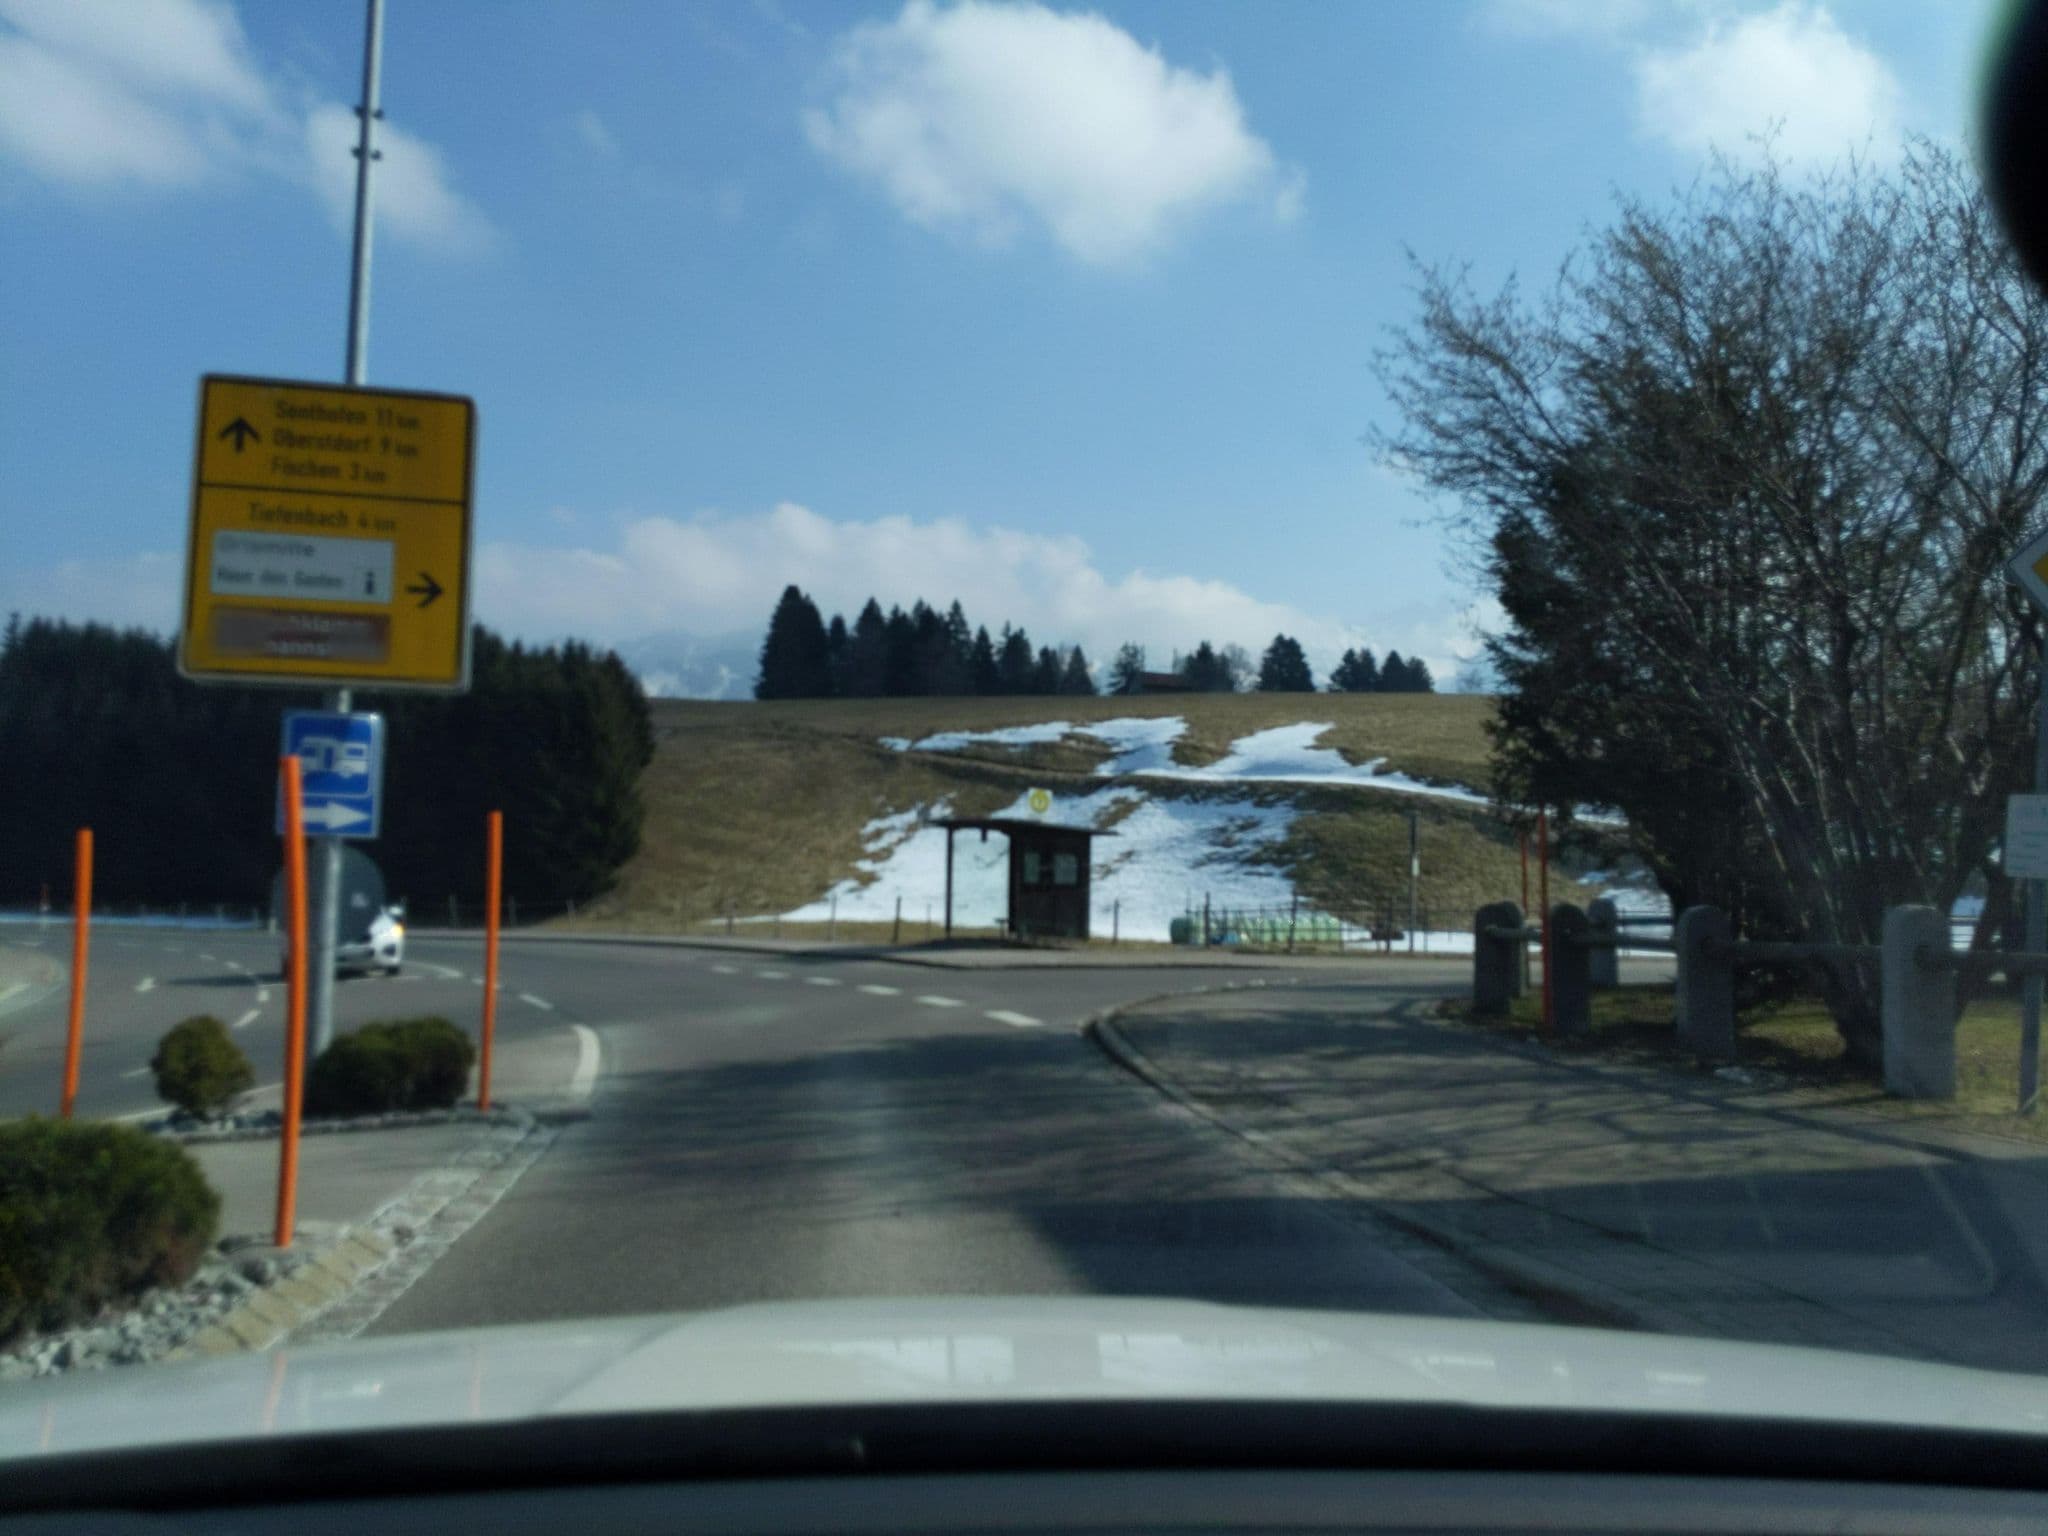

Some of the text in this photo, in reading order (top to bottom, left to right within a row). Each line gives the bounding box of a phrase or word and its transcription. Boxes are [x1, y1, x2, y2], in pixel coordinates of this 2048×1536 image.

[273, 427, 371, 452] Oberstdorf
[271, 455, 341, 478] Fischen
[248, 501, 349, 528] Tiefenbach
